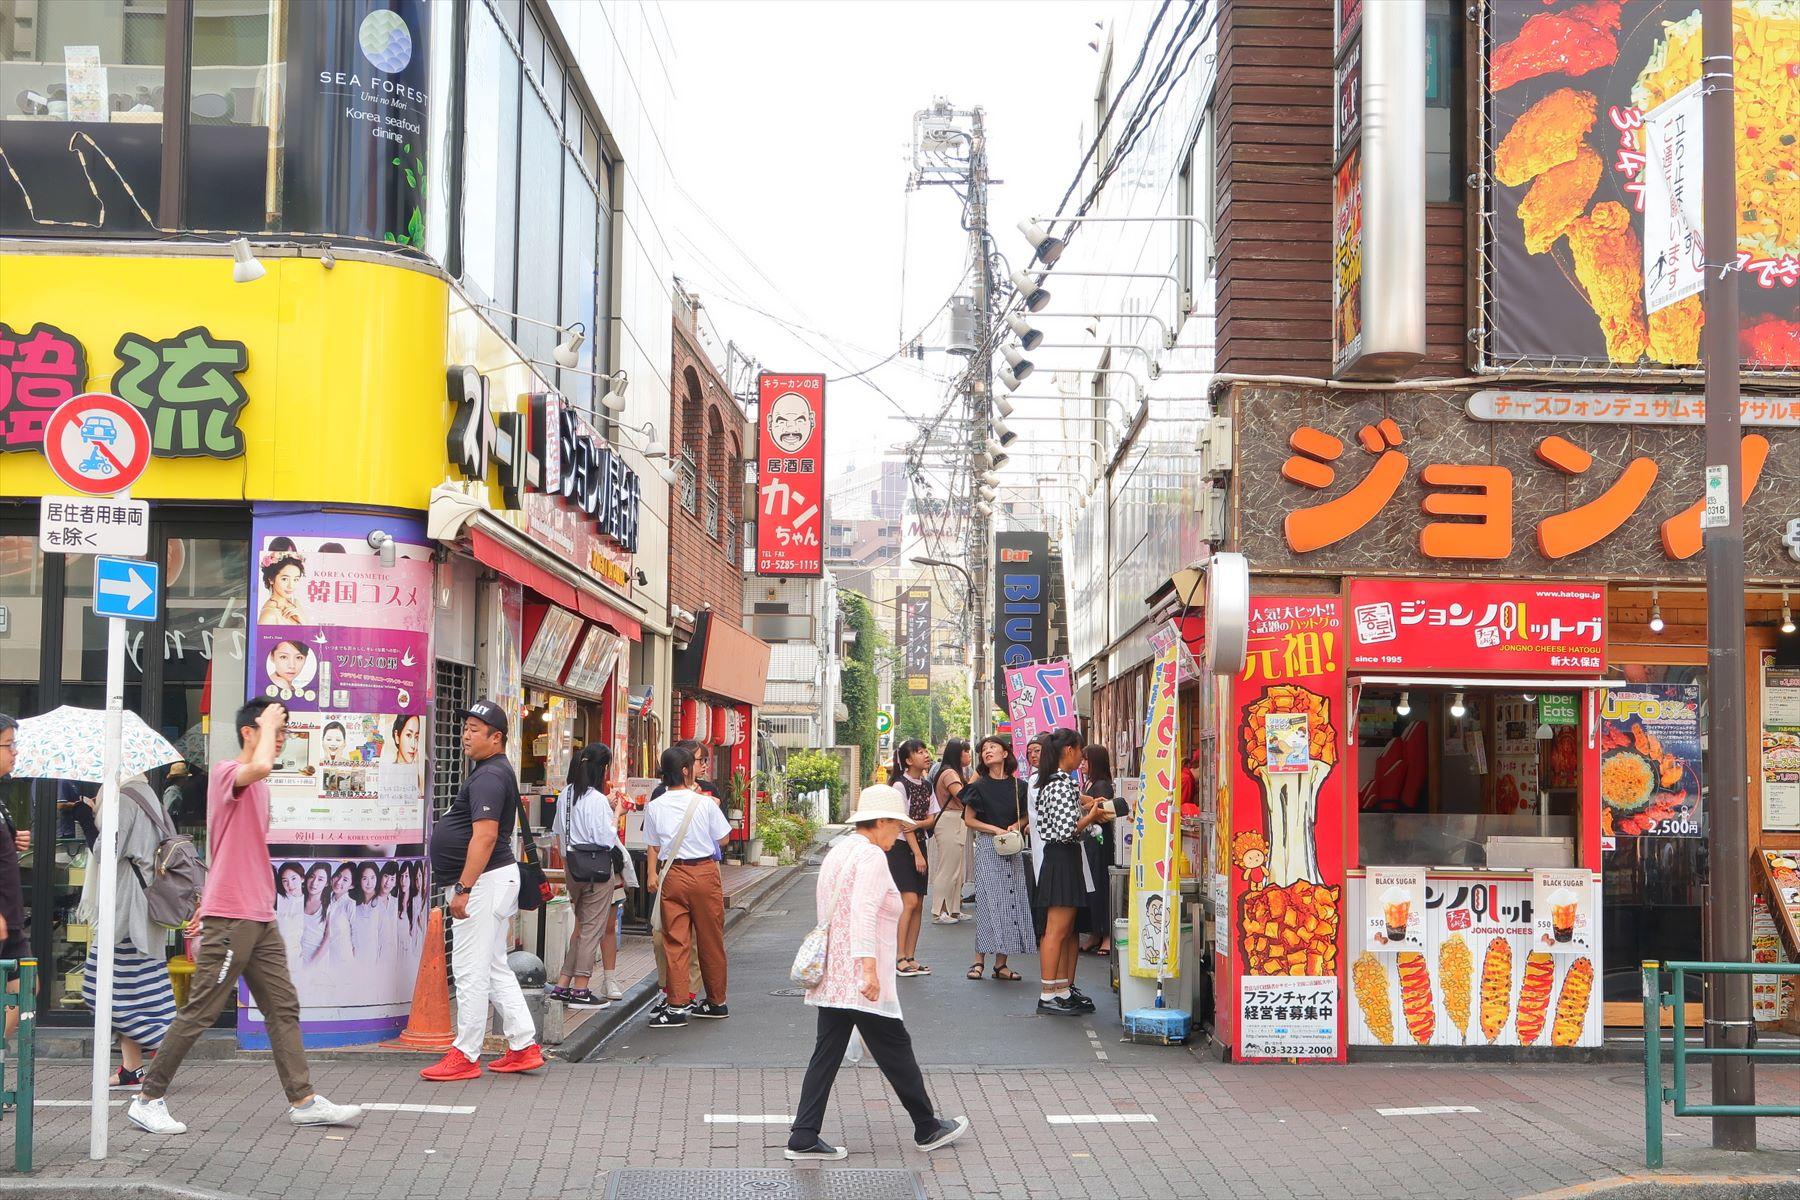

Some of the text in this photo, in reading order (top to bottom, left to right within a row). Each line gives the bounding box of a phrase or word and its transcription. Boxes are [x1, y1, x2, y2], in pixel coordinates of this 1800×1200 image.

[320, 71, 428, 106] SEA FOREST
[360, 91, 407, 110] Umi no Mori
[346, 106, 420, 134] Korea seafood
[372, 126, 403, 143] dining
[763, 378, 820, 389] キラーカンの店
[767, 459, 815, 474] 居酒屋
[762, 477, 819, 529] カン
[1707, 505, 1725, 515] 0318
[47, 502, 143, 526] 居住者用車両
[47, 527, 98, 547] を除く
[775, 525, 819, 547] ちゃん
[1001, 548, 1032, 562] Bar
[761, 559, 819, 570] 03-5285-1115
[347, 571, 390, 581] COSMETIC
[308, 580, 417, 607] 韓国コスメ
[1536, 591, 1600, 600] www.hatogu.jp
[1500, 644, 1601, 654] JONGNO CHEESE HATOGU
[1243, 631, 1336, 682] 元祖!
[1355, 655, 1402, 663] since 1995
[1550, 656, 1600, 667] 新大久保店
[1035, 668, 1068, 735] フリ
[1542, 694, 1574, 704] Uber
[1600, 688, 1661, 722] UFO
[1543, 705, 1575, 717] Eats
[1543, 879, 1562, 887] BLACK
[1370, 919, 1384, 927] 550
[1537, 920, 1551, 928] 550
[1471, 926, 1505, 935] JONGNO
[1244, 990, 1334, 1005] フランチャイズ
[1244, 1005, 1333, 1020] 経営者募集中
[1264, 1046, 1333, 1055] 03-3232-2000
